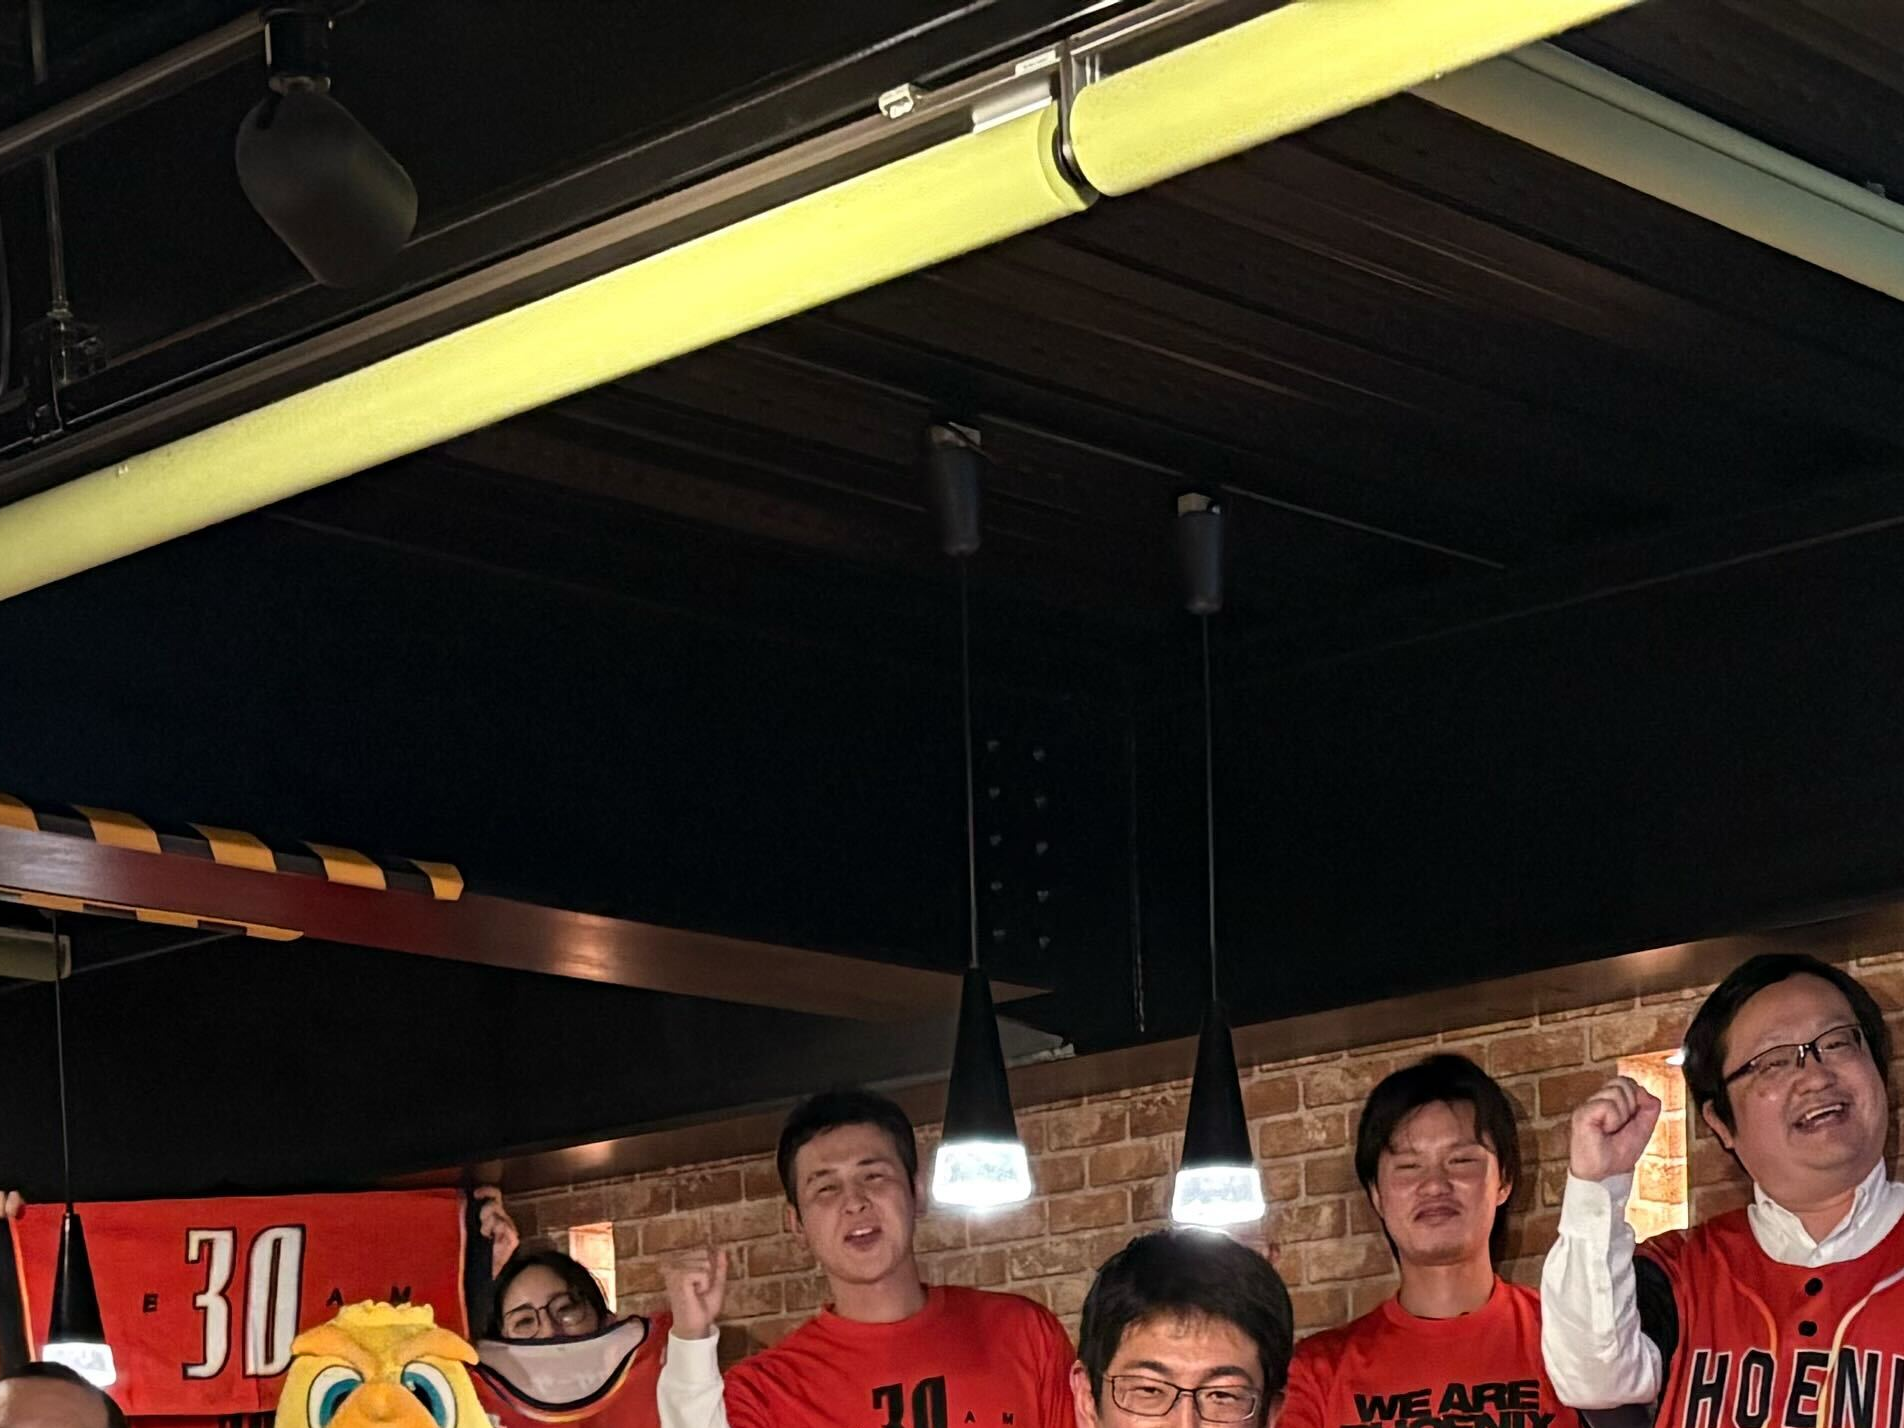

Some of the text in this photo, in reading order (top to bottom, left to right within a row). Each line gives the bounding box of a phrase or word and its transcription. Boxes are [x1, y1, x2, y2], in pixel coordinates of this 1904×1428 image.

[182, 1224, 306, 1381] 30
[1354, 1379, 1540, 1422] WE ARE
